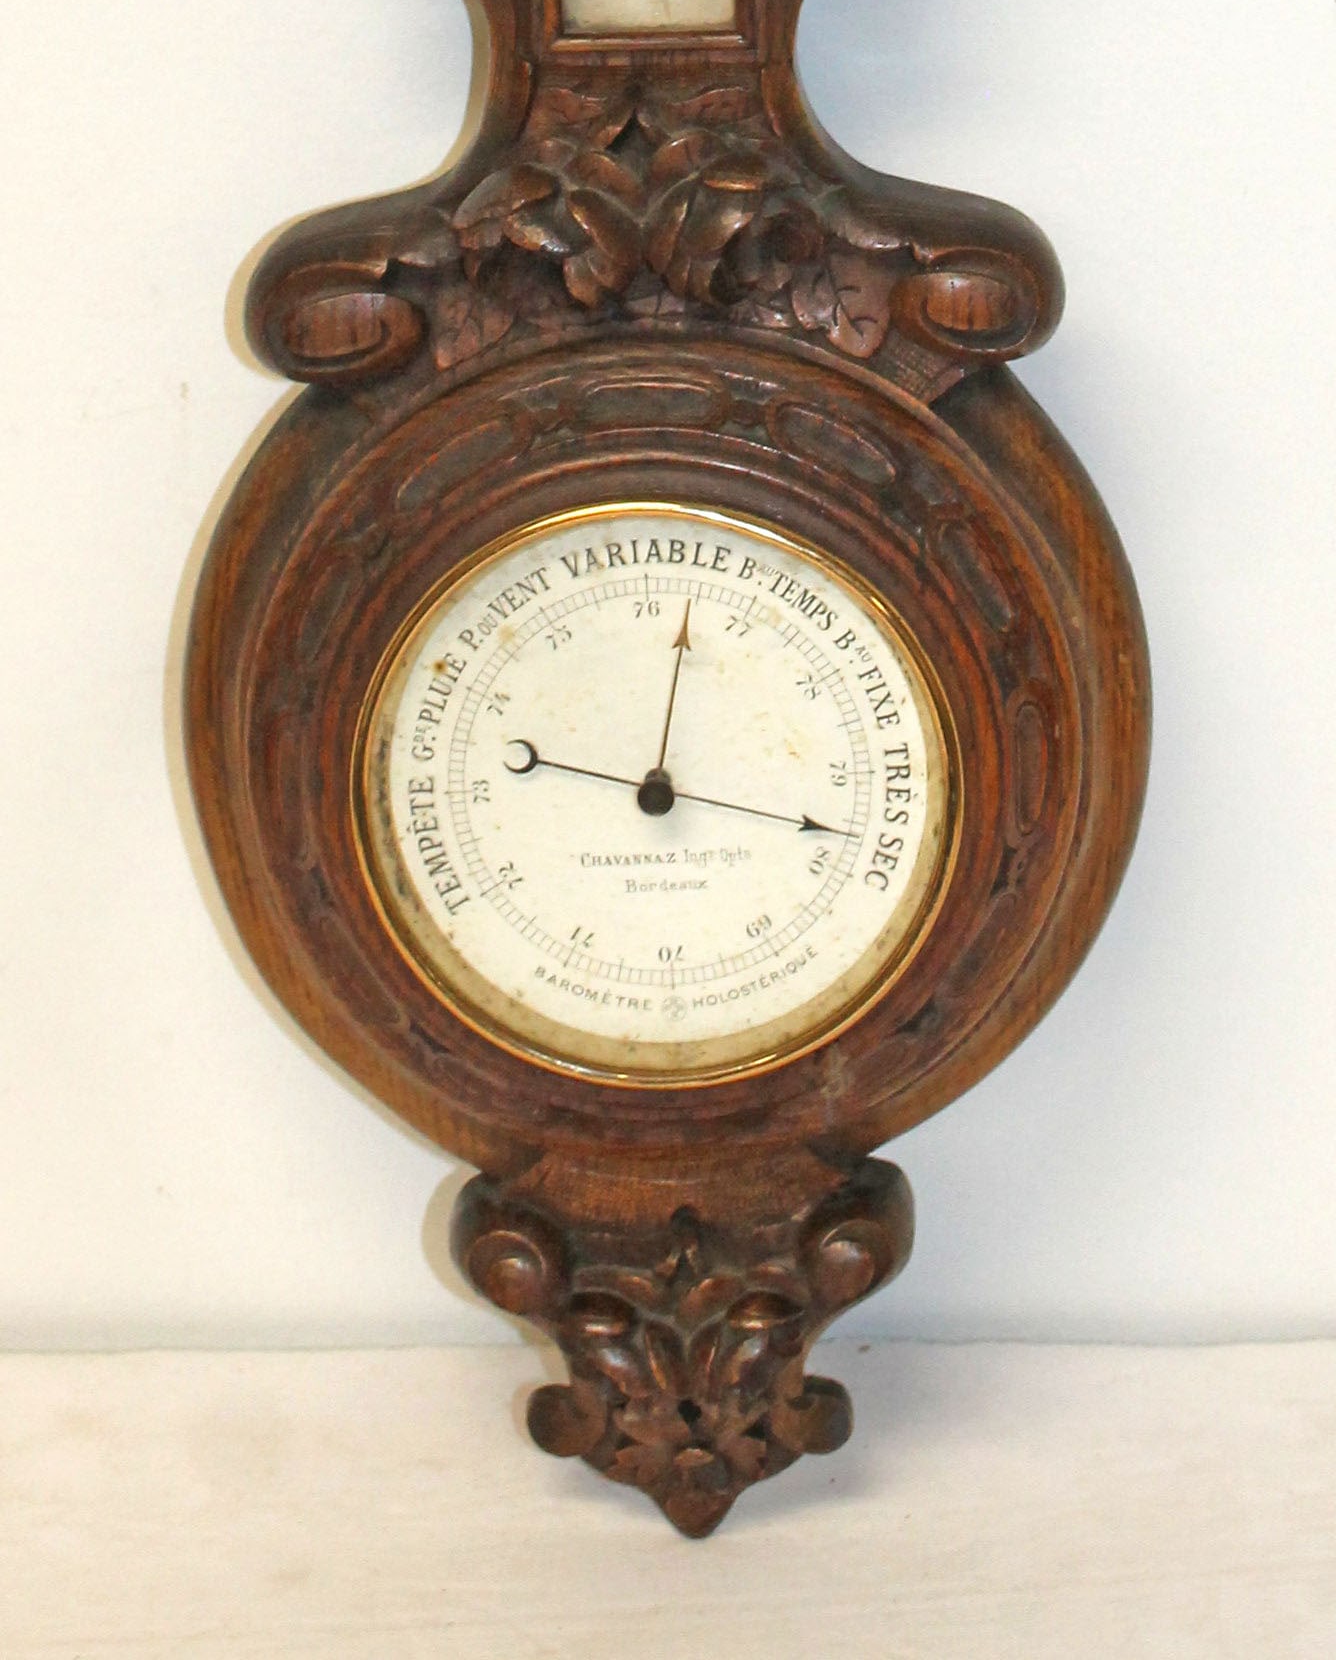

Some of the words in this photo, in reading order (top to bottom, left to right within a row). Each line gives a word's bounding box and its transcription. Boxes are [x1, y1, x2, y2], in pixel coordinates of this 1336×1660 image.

[633, 601, 660, 619] 76
[545, 624, 572, 650] 75
[725, 615, 753, 638] 77
[417, 653, 467, 726] PLUIE
[560, 538, 731, 578] VARIABLE
[769, 573, 838, 631] TEMPS
[864, 832, 905, 892] SEC
[487, 692, 511, 716] 74
[829, 760, 847, 787] 79
[473, 779, 491, 803] 73
[581, 852, 677, 868] CHAVANNAZ
[808, 845, 831, 875] 80
[625, 878, 708, 893] Bordeaux
